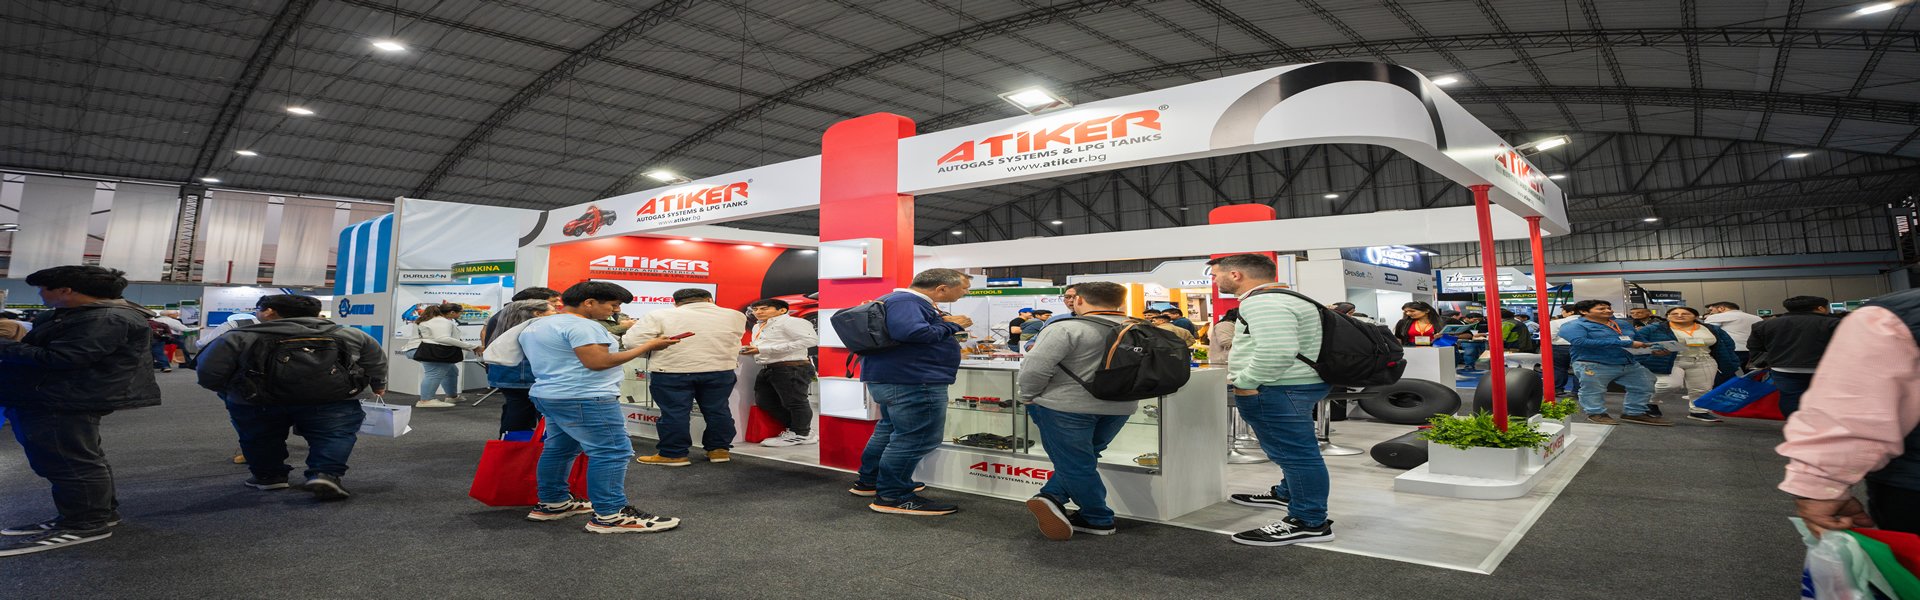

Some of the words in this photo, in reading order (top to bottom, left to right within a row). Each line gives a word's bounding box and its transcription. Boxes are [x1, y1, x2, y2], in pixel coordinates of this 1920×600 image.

[938, 159, 994, 174] AUTOGAS
[998, 149, 1058, 164] SYSTEMS
[1062, 147, 1074, 155] &
[1077, 142, 1105, 153] LPG
[1109, 133, 1162, 147] TANKS
[1007, 153, 1107, 172] www.atiker.bg
[636, 214, 666, 223] AUTOGAS
[667, 208, 697, 217] SYSTEMS
[706, 204, 720, 212] LPG
[722, 200, 748, 209] TANKS
[658, 215, 701, 226] www.atiker.bg
[466, 265, 500, 273] MAKINA
[969, 471, 996, 479] AUTOGAS
[997, 476, 1024, 484] SYSTEMS
